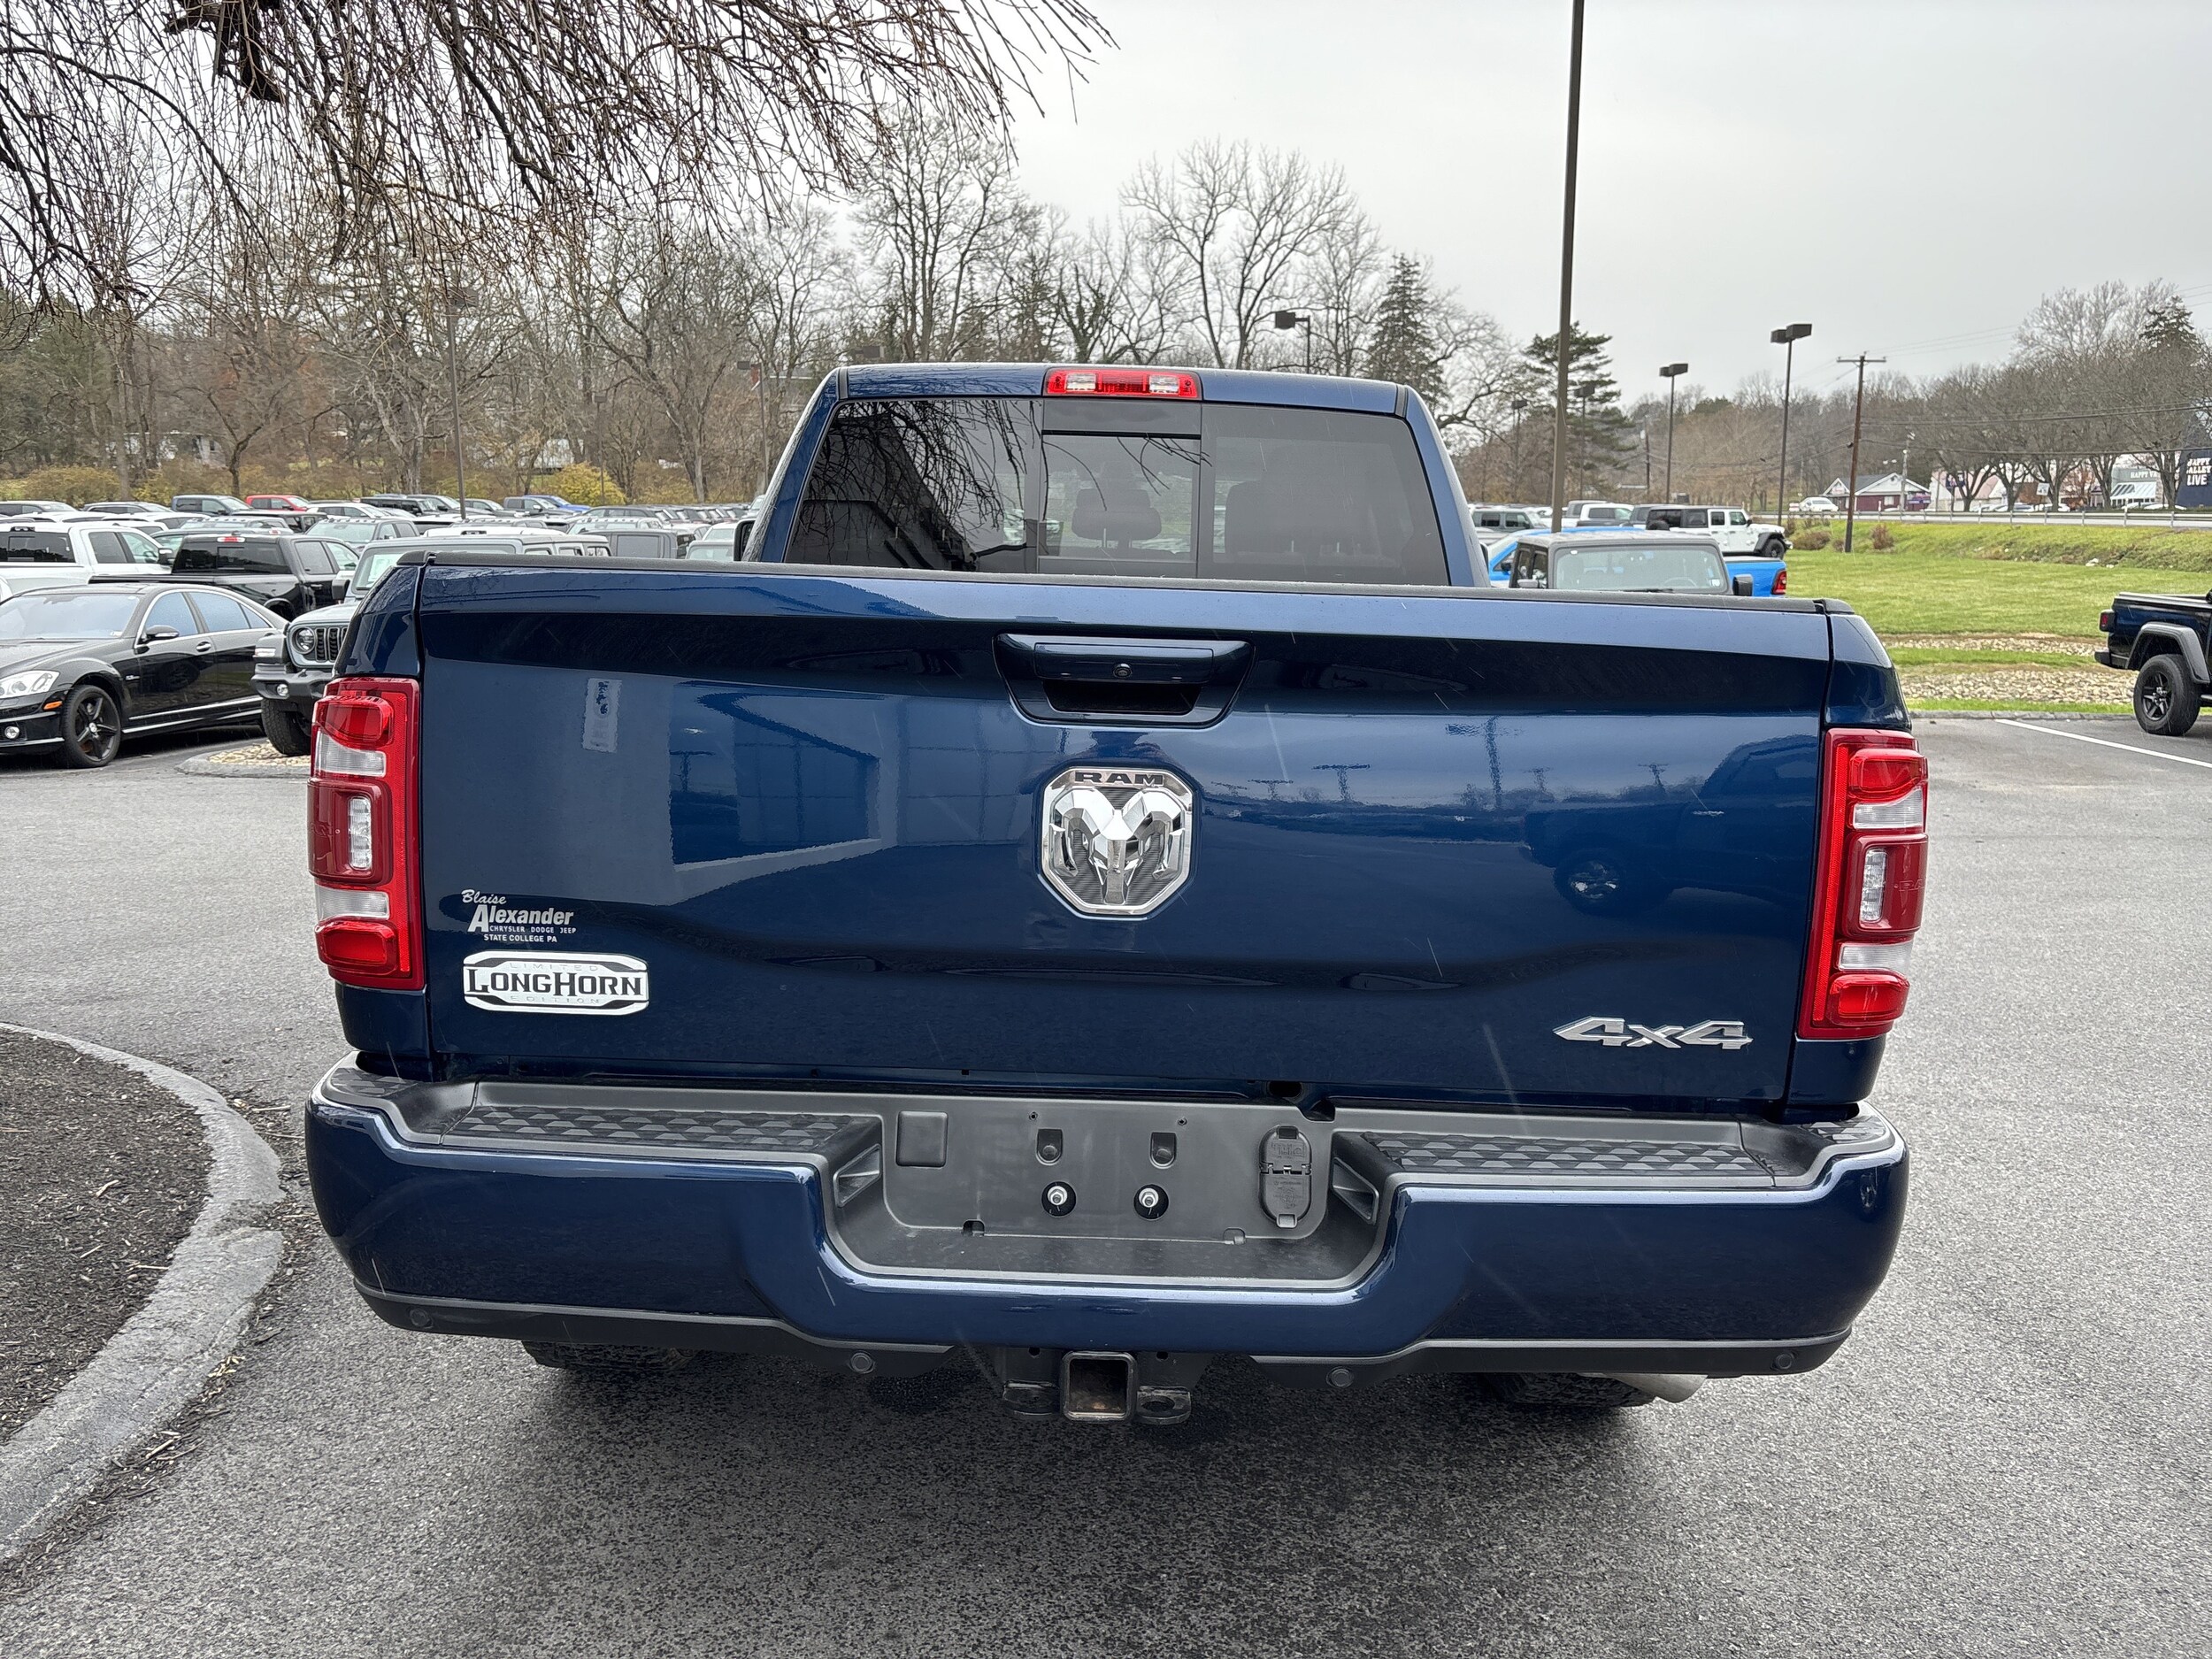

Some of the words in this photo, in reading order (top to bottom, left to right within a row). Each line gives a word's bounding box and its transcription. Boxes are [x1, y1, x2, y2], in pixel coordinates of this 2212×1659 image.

[2187, 474, 2208, 486] LIVE
[1075, 772, 1163, 786] RAM
[461, 888, 507, 905] Blaise
[467, 903, 574, 933] Alexander
[510, 963, 598, 972] LIMITED
[510, 995, 599, 1004] EDITION
